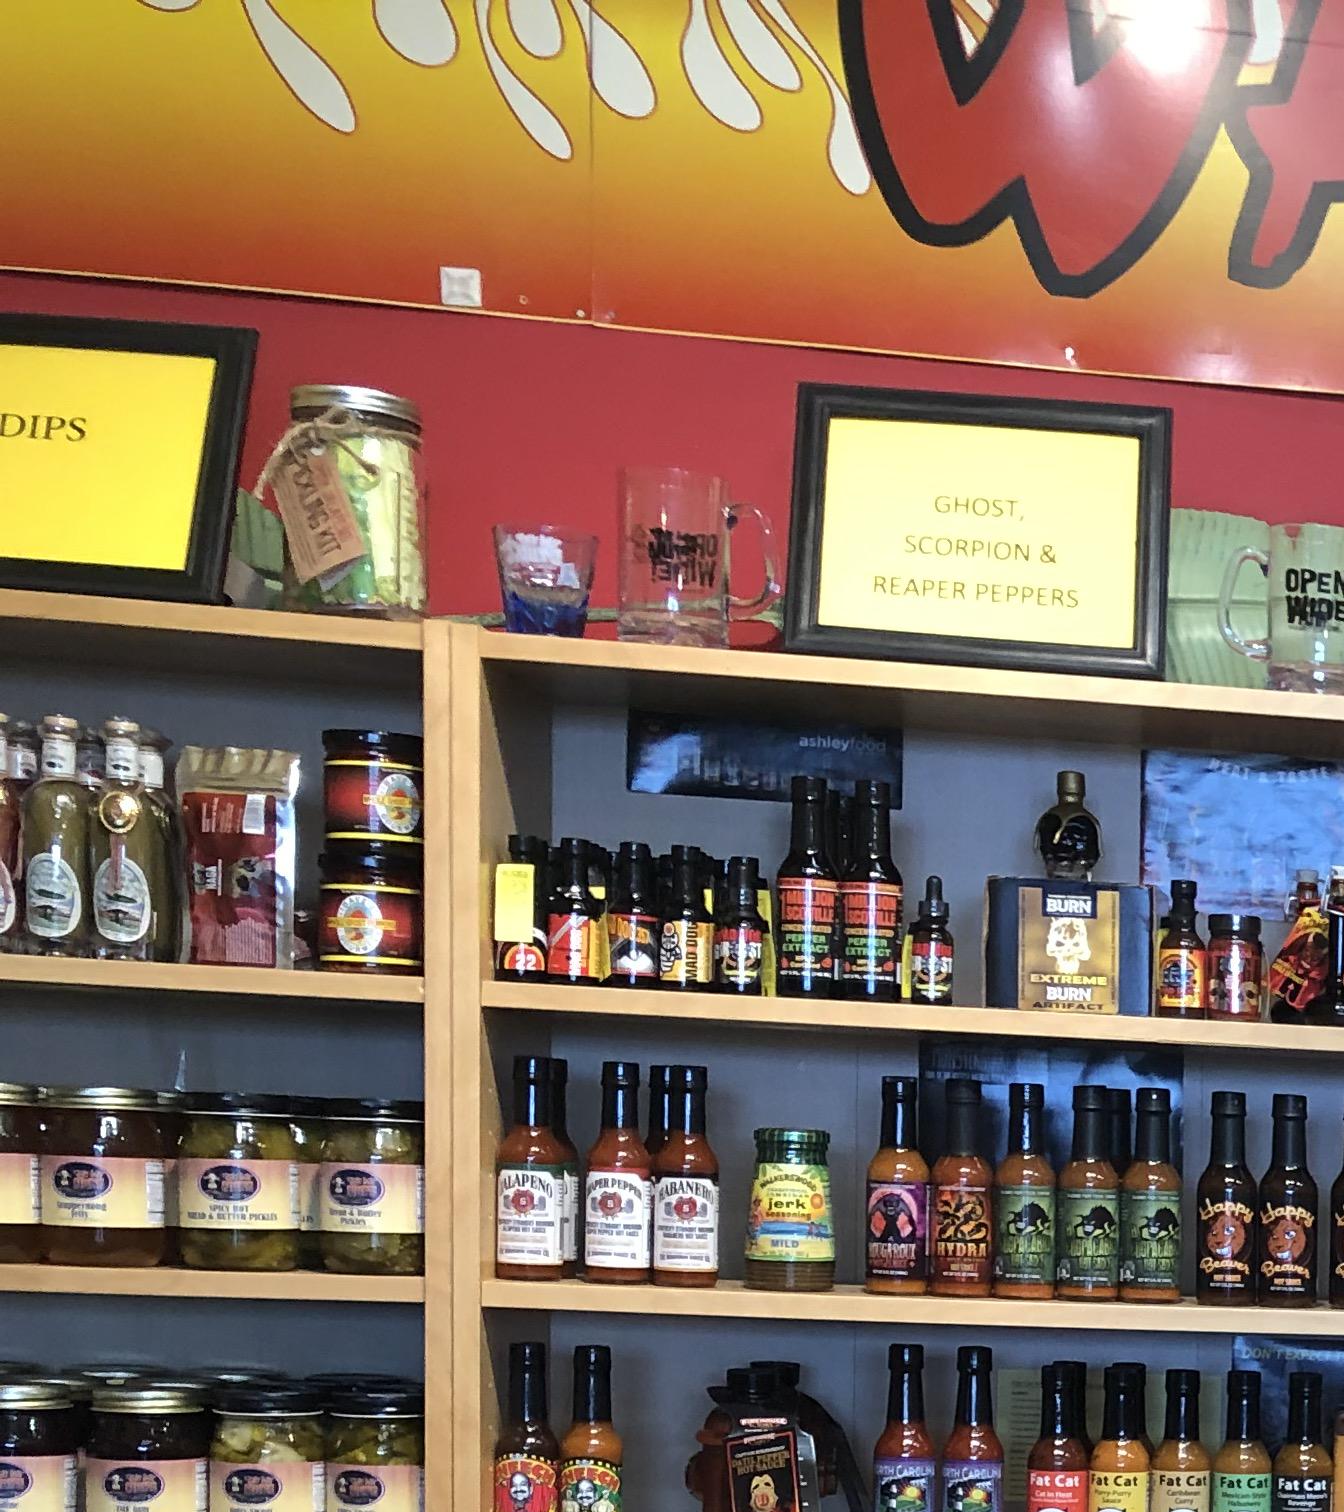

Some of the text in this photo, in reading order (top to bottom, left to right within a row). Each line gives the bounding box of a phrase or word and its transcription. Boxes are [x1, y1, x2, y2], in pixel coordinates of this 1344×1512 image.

[0, 410, 87, 446] DIPS
[933, 494, 1027, 522] GHOST,
[903, 534, 1058, 565] SCORPION &
[873, 575, 1080, 609] REAPER PEPPERS
[1046, 897, 1091, 915] BURN
[1030, 974, 1107, 985] EXTREME
[1047, 985, 1091, 1001] BURN
[767, 1198, 806, 1211] jerk
[1200, 1197, 1254, 1226] Happy
[1260, 1201, 1314, 1229] Happy
[771, 1239, 799, 1247] MILD
[1030, 1473, 1080, 1488] Fat Cat
[1090, 1473, 1138, 1487] Fat Cat
[1159, 1473, 1207, 1487] Fat Cat
[1220, 1477, 1268, 1488] Fat Cat
[1278, 1479, 1326, 1491] Fat Cat
